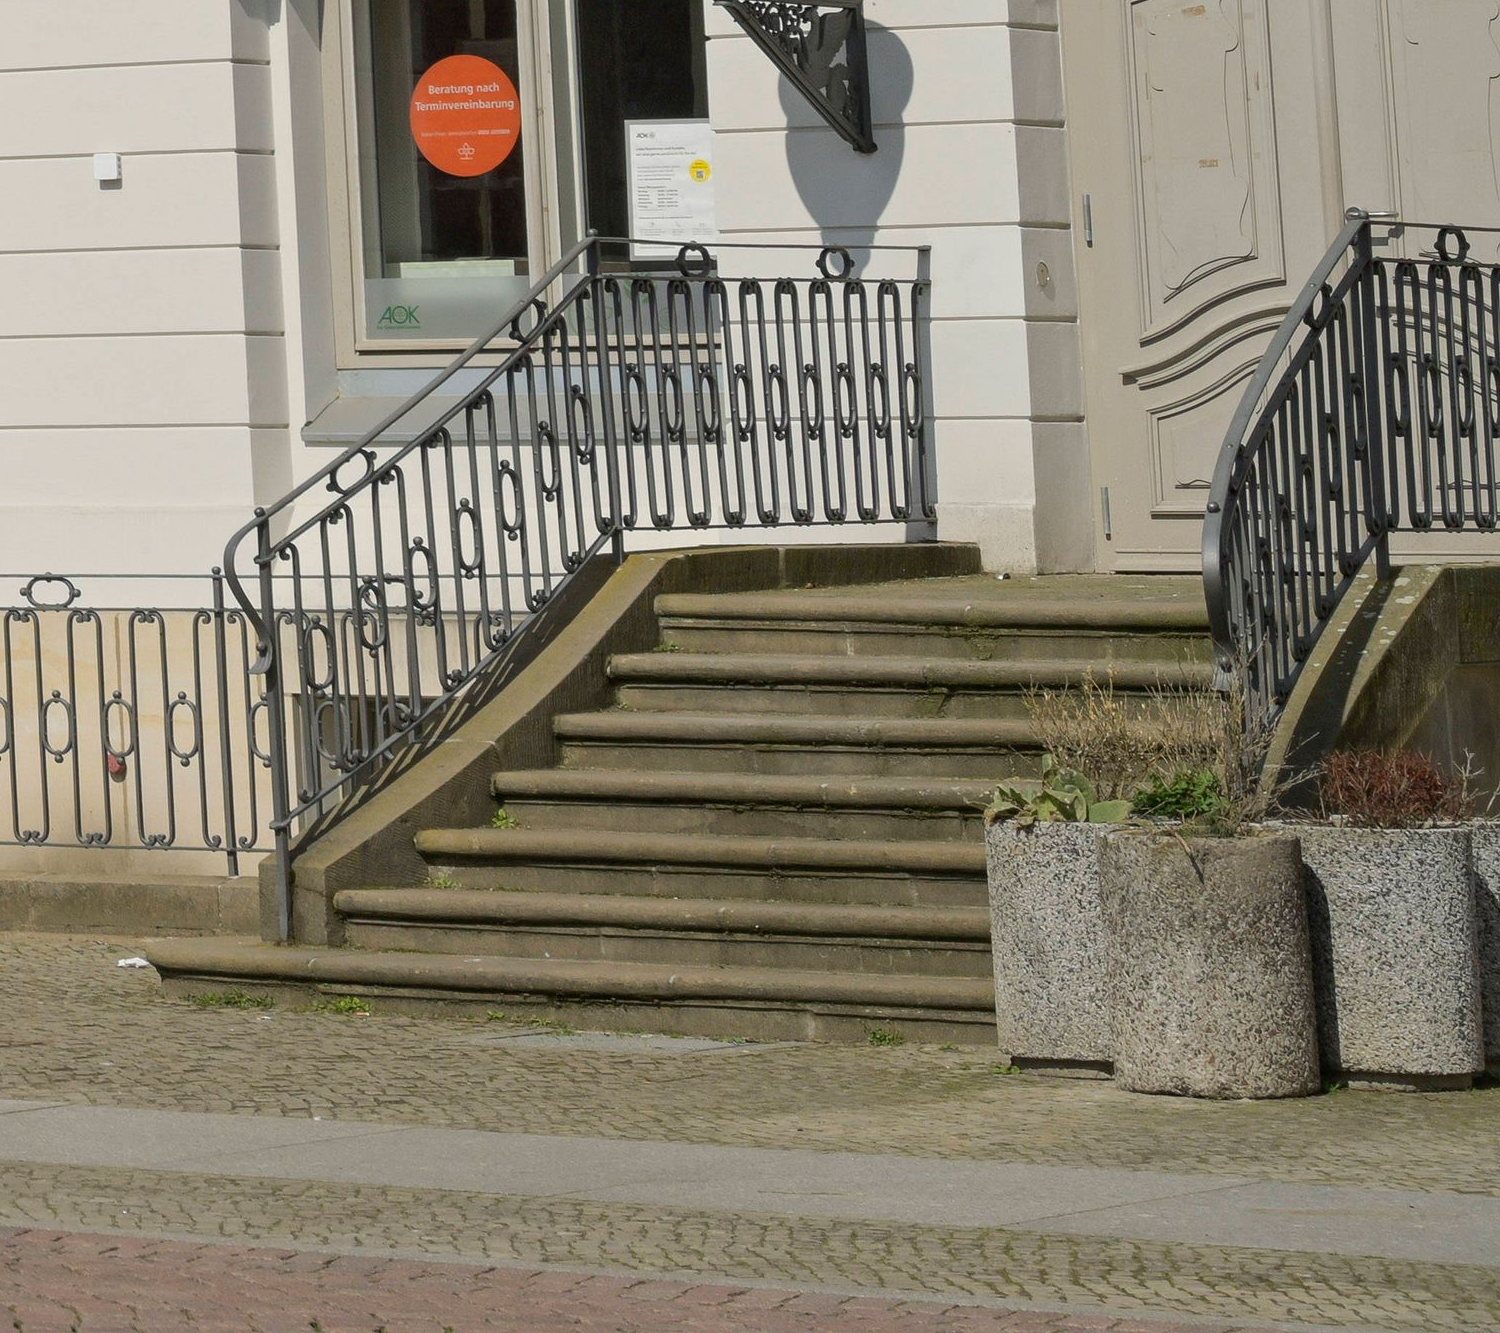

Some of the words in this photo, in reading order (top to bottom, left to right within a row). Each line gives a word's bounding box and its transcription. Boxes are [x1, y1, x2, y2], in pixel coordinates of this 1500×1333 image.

[428, 85, 473, 95] Beratung
[476, 82, 500, 92] nach
[415, 100, 515, 111] Terminvereinbarung
[379, 305, 420, 325] AOK
